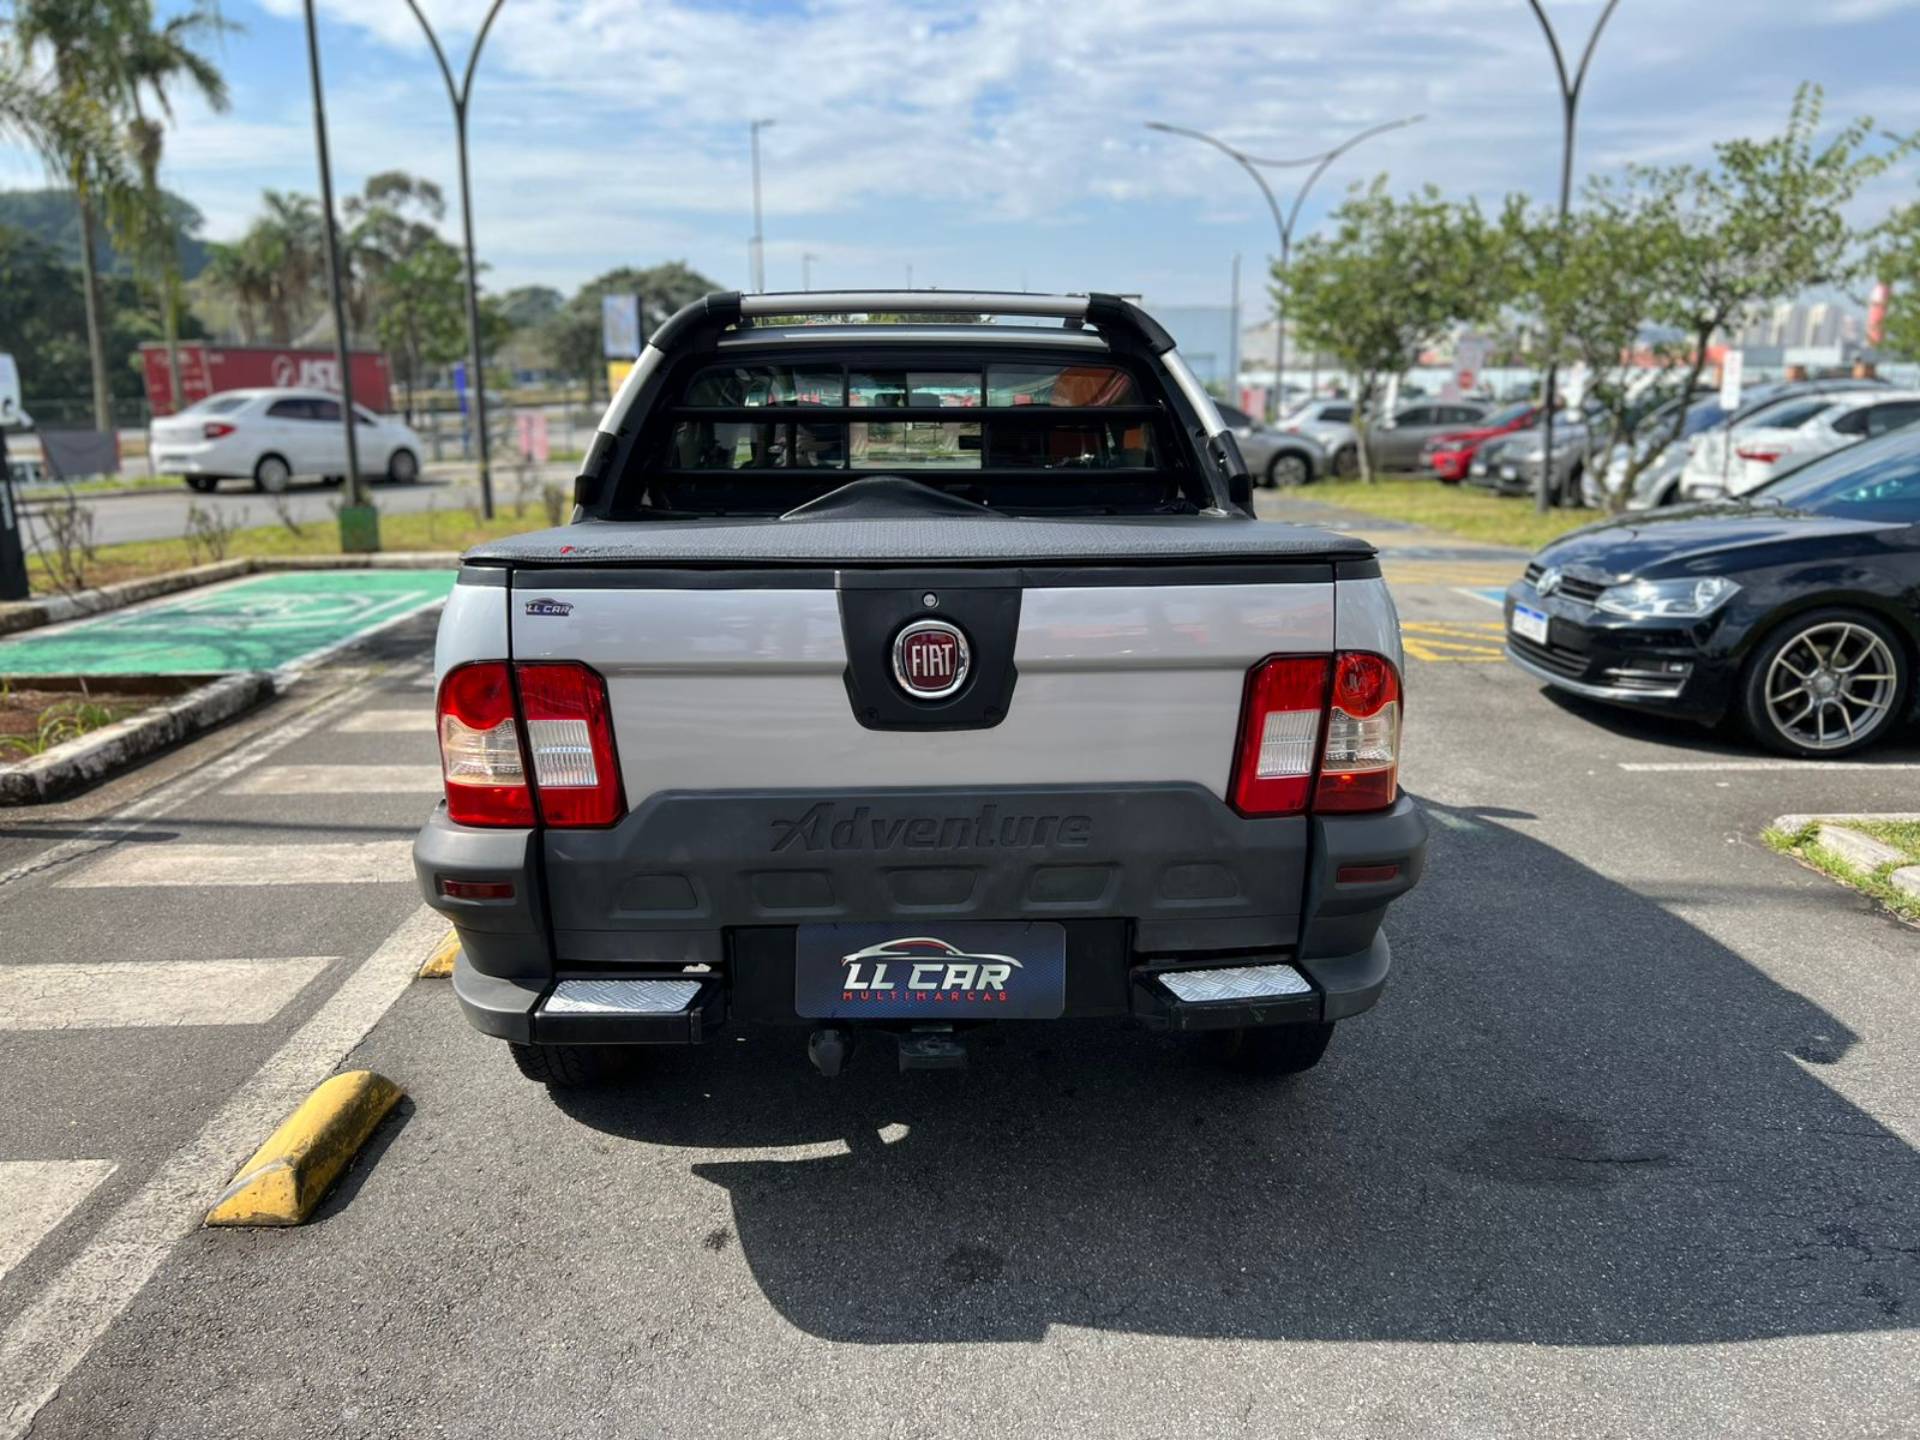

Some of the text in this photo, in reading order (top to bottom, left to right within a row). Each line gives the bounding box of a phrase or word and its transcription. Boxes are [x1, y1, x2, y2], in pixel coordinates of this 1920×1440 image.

[543, 605, 570, 613] CAR
[911, 644, 953, 677] FIAT
[771, 801, 1093, 852] Adventure
[843, 963, 1011, 990] LL CAR
[842, 991, 1008, 1001] MULTIMARCAS
